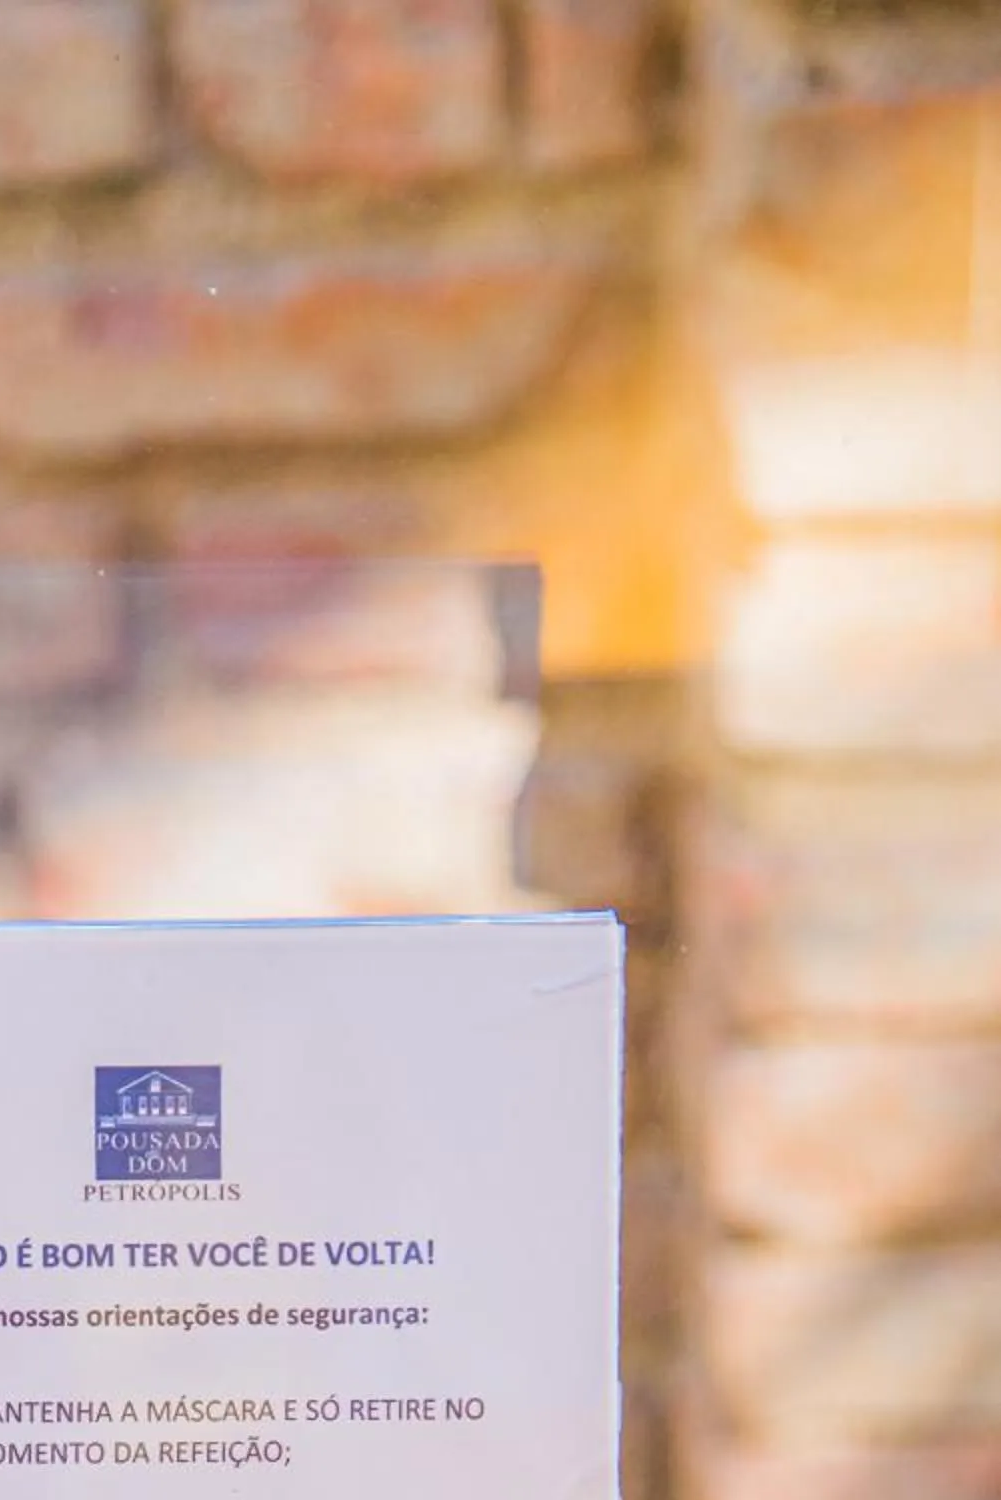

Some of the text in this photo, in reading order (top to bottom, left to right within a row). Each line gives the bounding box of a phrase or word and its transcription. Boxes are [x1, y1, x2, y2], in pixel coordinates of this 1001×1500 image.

[96, 1131, 221, 1151] POUSADA
[128, 1155, 188, 1174] DOM
[83, 1176, 242, 1202] PETRÓPOLIS
[16, 1236, 34, 1269] É
[41, 1242, 115, 1270] BOM
[122, 1242, 179, 1269] TER
[186, 1235, 269, 1268] VOCÊ
[277, 1241, 316, 1267] DE
[323, 1238, 435, 1267] VOLTA!
[86, 1302, 240, 1332] orientações
[246, 1301, 280, 1326] de
[286, 1306, 430, 1332] segurança:
[120, 1399, 139, 1423] A
[146, 1394, 276, 1423] MÁSCARA
[283, 1399, 298, 1422] E
[305, 1393, 341, 1422] SÓ
[349, 1397, 436, 1422] RETIRE
[445, 1396, 485, 1421] NO
[114, 1441, 151, 1465] DA
[158, 1435, 291, 1469] REFEIÇÃO;
